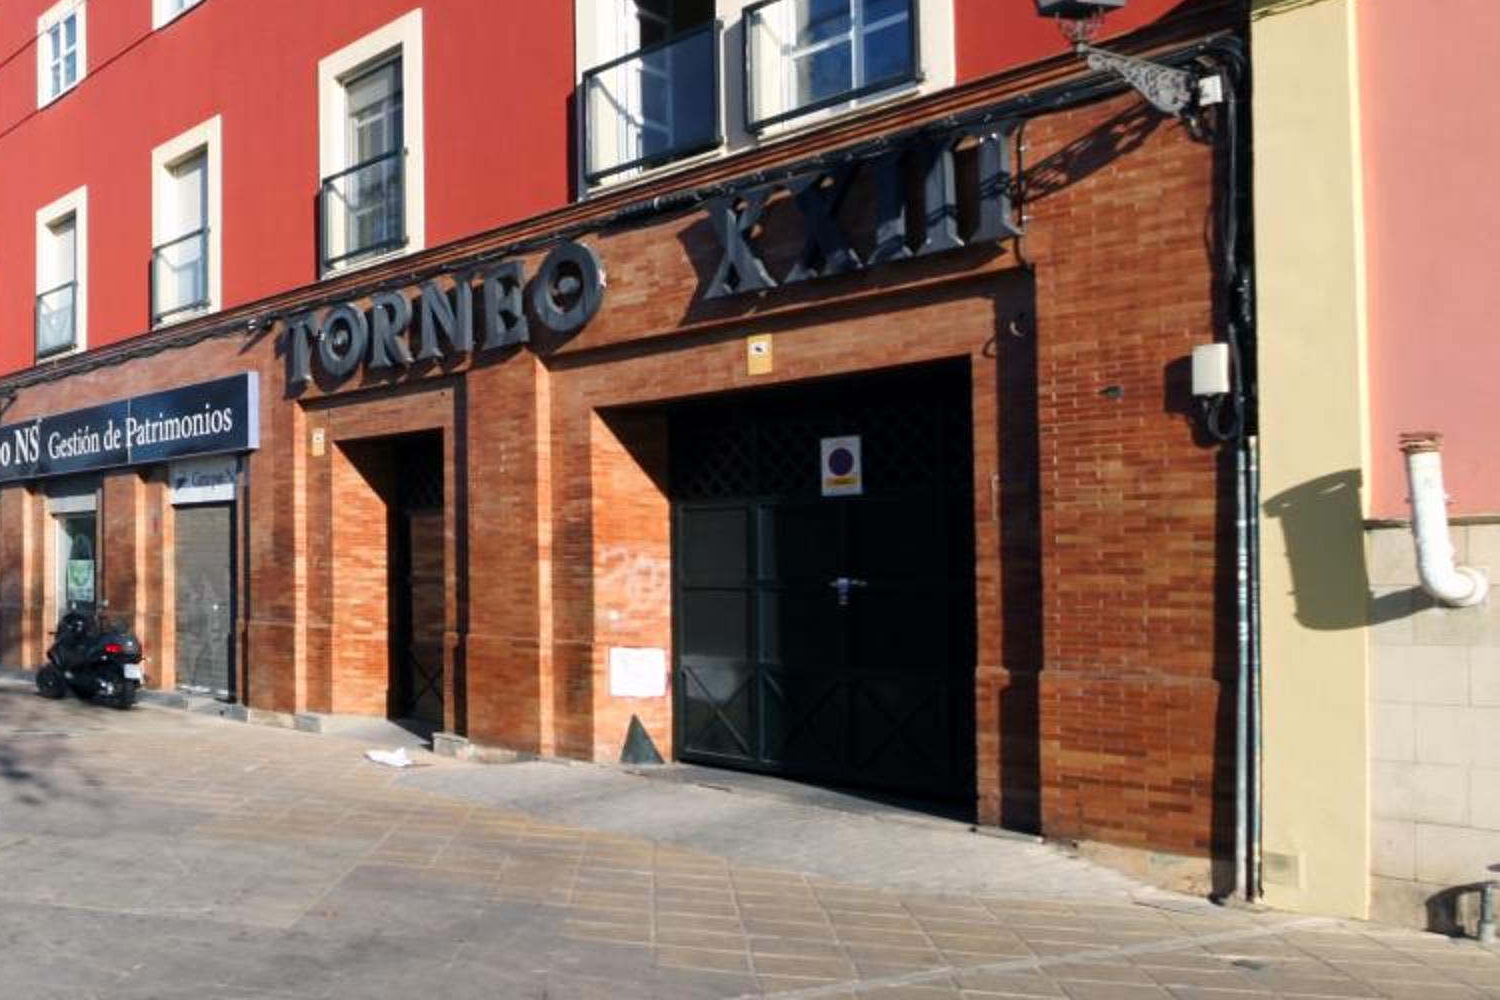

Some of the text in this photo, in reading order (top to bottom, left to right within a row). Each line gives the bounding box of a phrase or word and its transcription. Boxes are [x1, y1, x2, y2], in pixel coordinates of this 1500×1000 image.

[283, 236, 606, 384] TORNEO
[14, 425, 41, 465] NS
[48, 426, 100, 459] Gestión
[103, 418, 121, 450] de
[125, 403, 233, 447] Patrimonios
